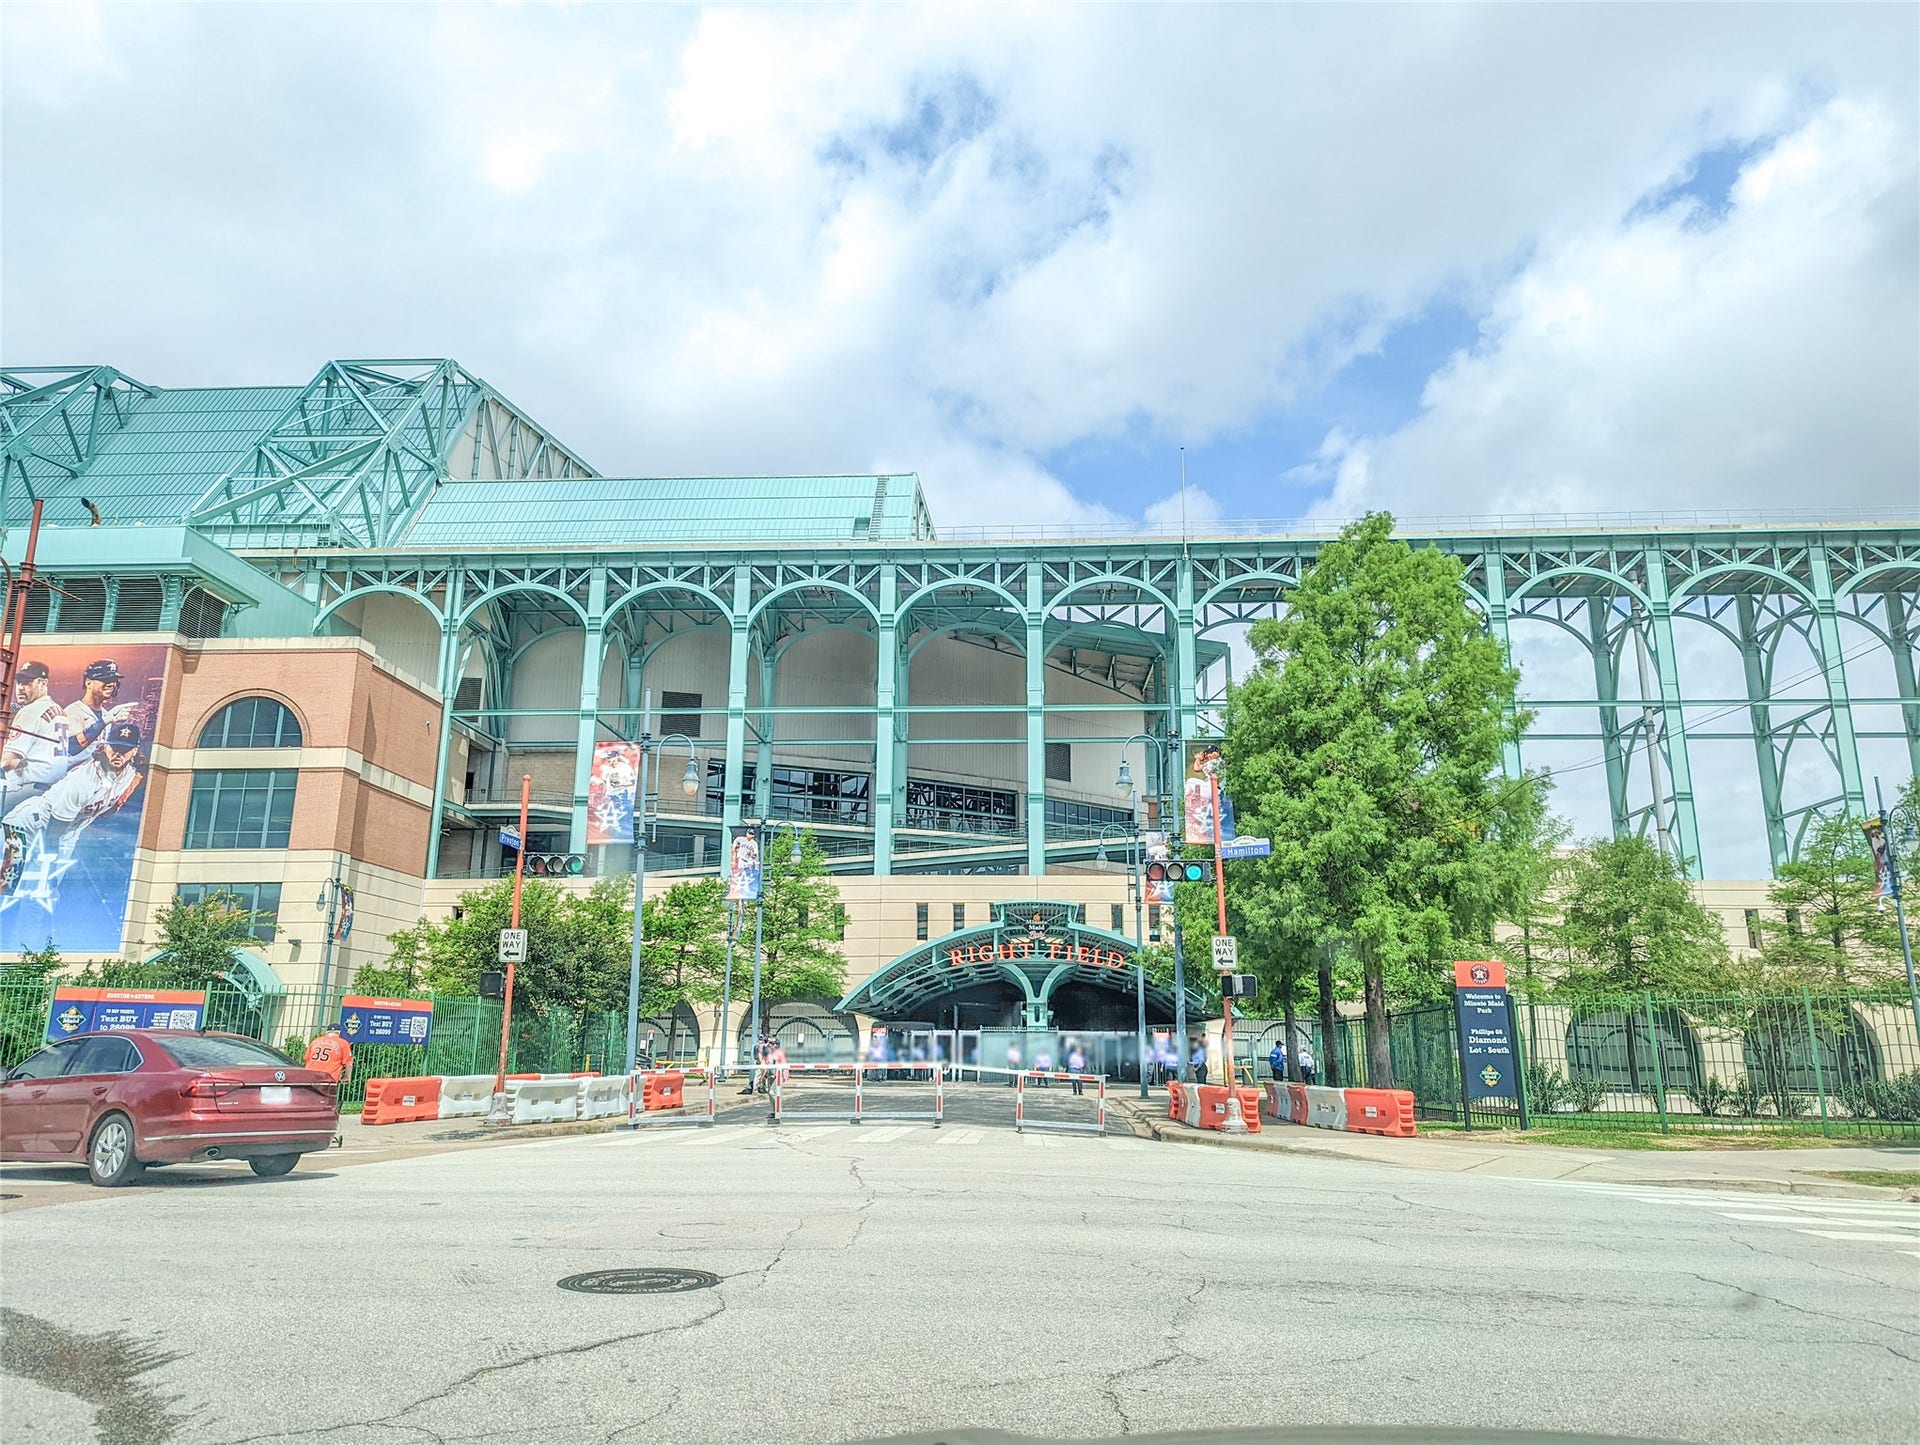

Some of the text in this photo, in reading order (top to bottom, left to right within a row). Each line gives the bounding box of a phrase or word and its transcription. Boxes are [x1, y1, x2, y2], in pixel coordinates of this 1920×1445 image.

[501, 832, 520, 847] Preston
[1227, 847, 1264, 856] Hamilton
[503, 932, 521, 940] ONE
[502, 940, 521, 949] WAY
[1215, 939, 1233, 947] ONE
[950, 943, 1125, 969] RIGHT FIELD
[1215, 947, 1234, 956] WAY
[1469, 1036, 1507, 1044] Diamond
[311, 1047, 331, 1062] 35
